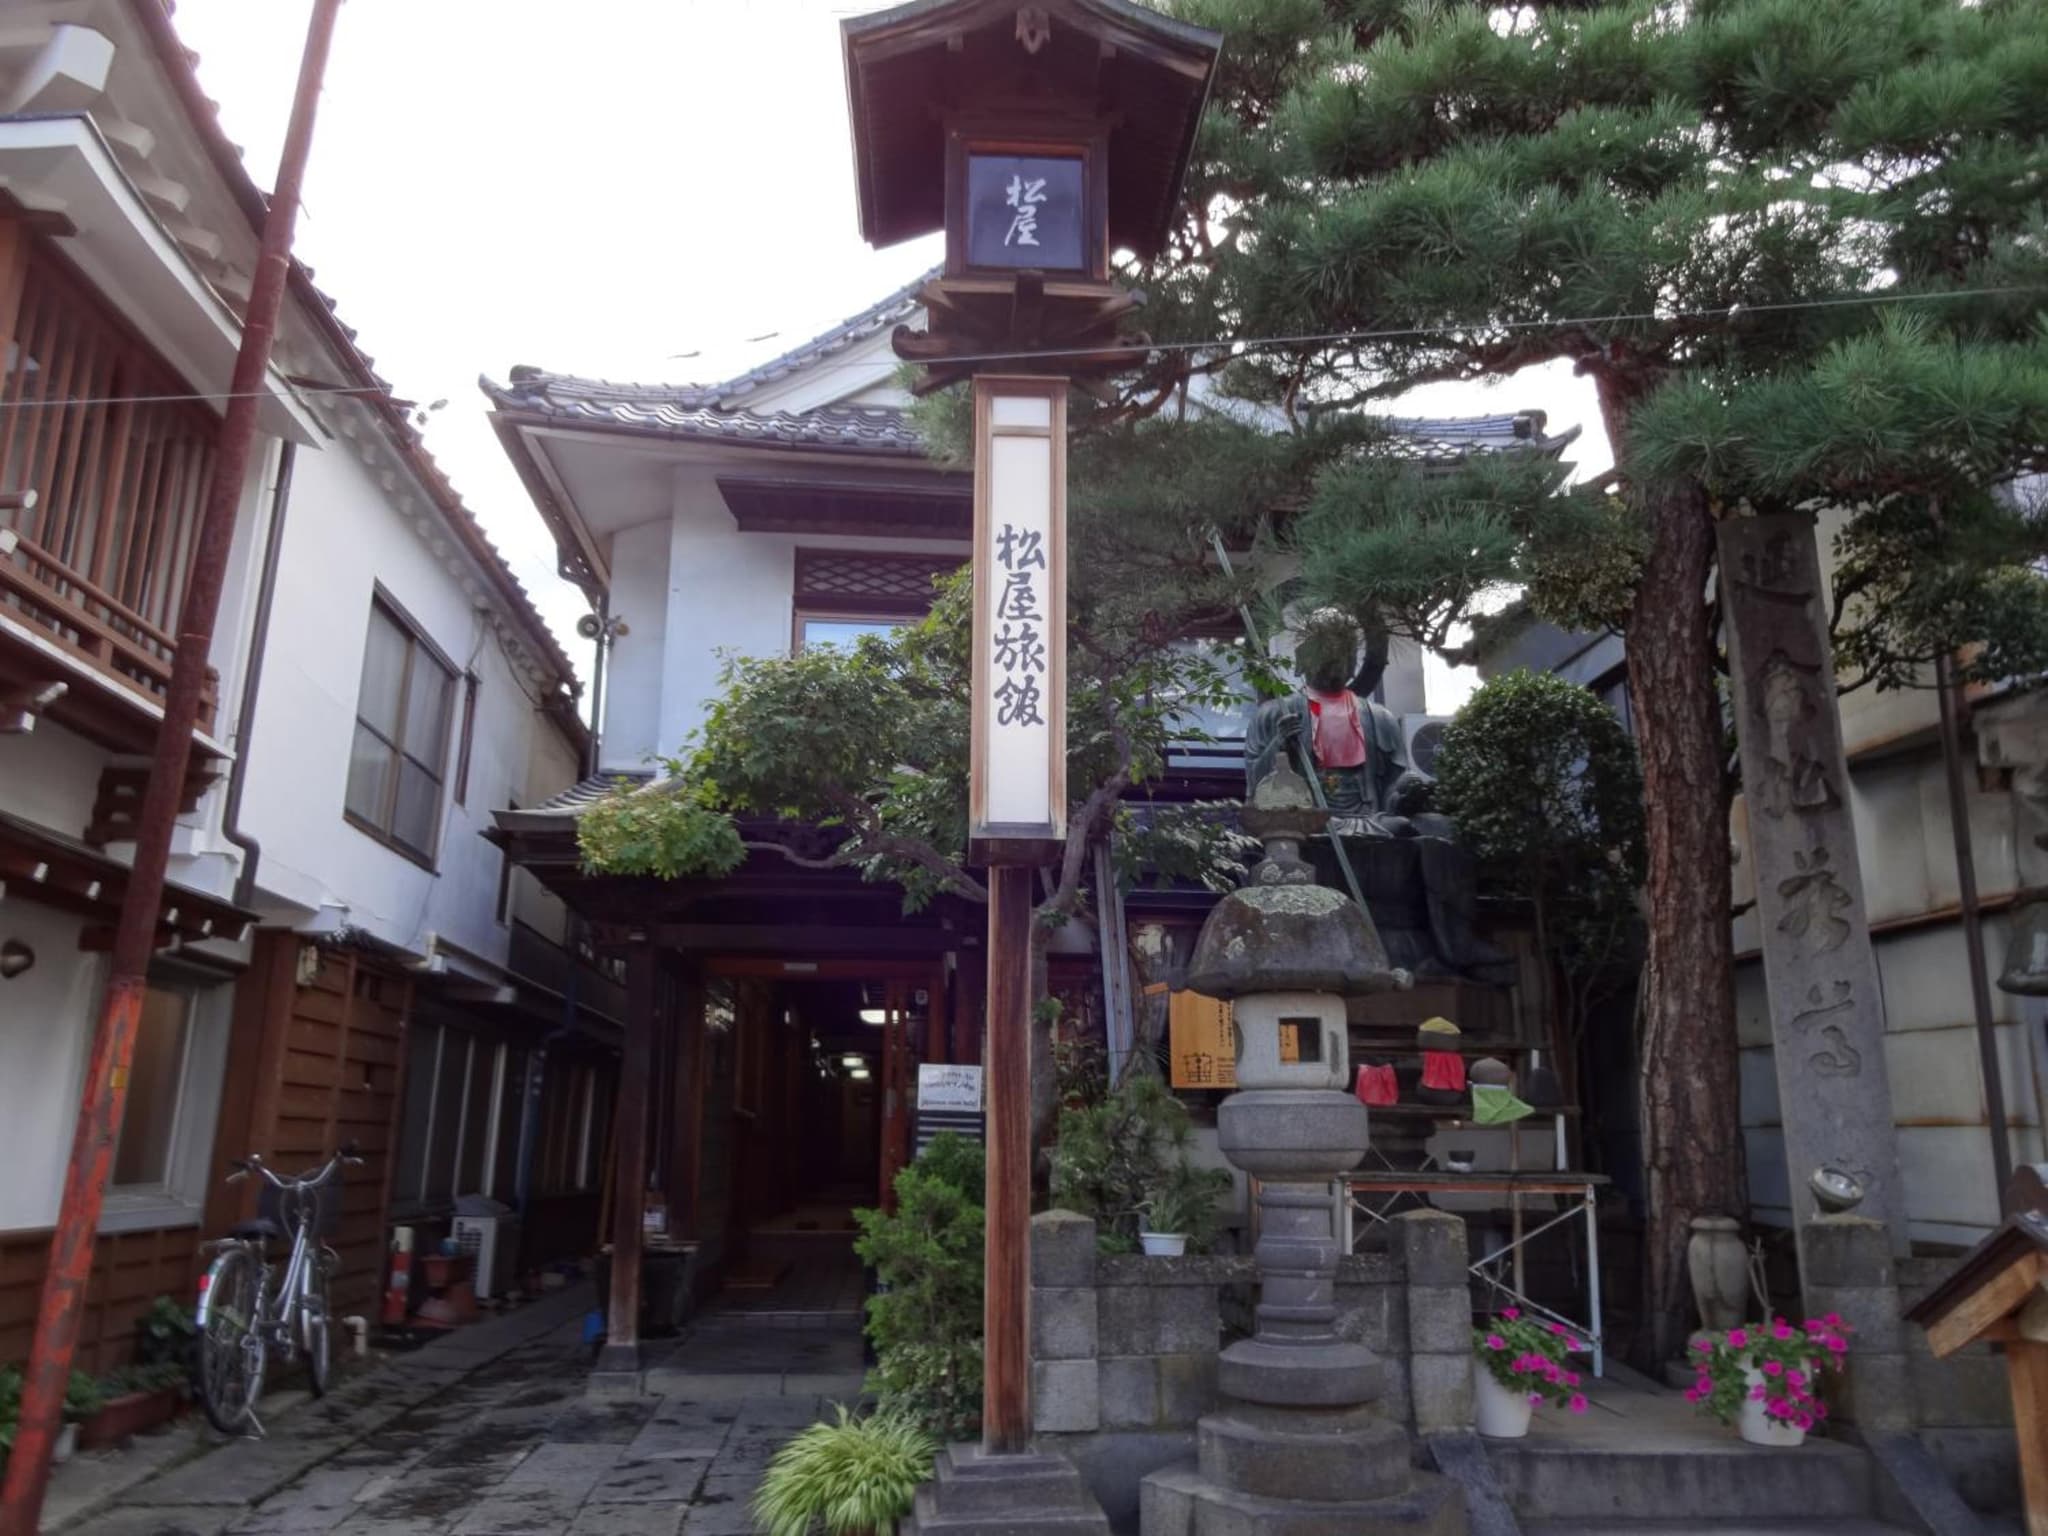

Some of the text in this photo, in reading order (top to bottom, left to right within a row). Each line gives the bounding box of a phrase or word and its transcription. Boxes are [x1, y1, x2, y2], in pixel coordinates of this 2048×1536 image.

[1004, 175, 1047, 247] 松屋
[993, 523, 1046, 727] 松屋旅館
